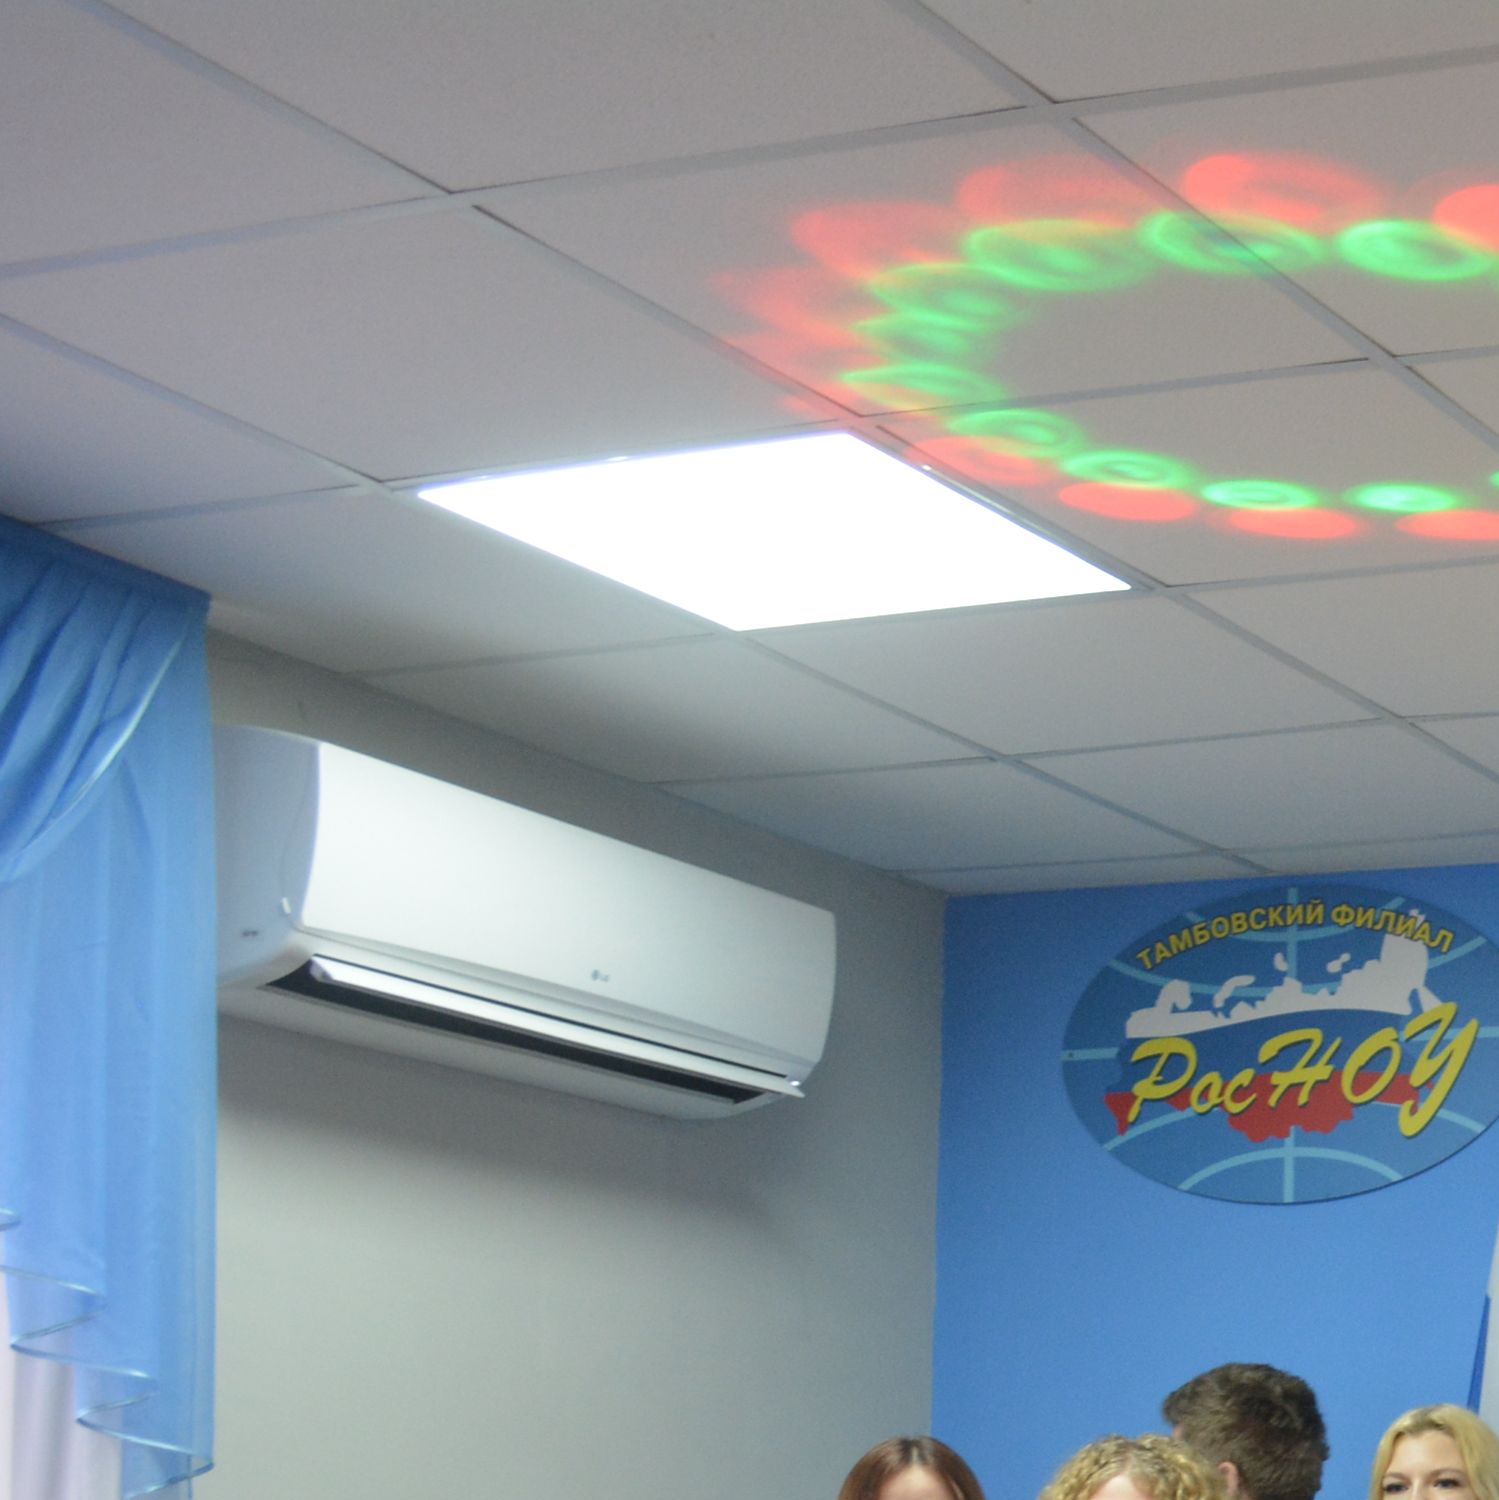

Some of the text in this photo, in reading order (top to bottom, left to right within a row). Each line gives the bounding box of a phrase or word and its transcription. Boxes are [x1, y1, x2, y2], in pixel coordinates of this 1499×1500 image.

[1136, 899, 1456, 970] ТАМБОВСКИЙ ФИЛИАЛ
[1127, 1002, 1480, 1138] РосНОУ
